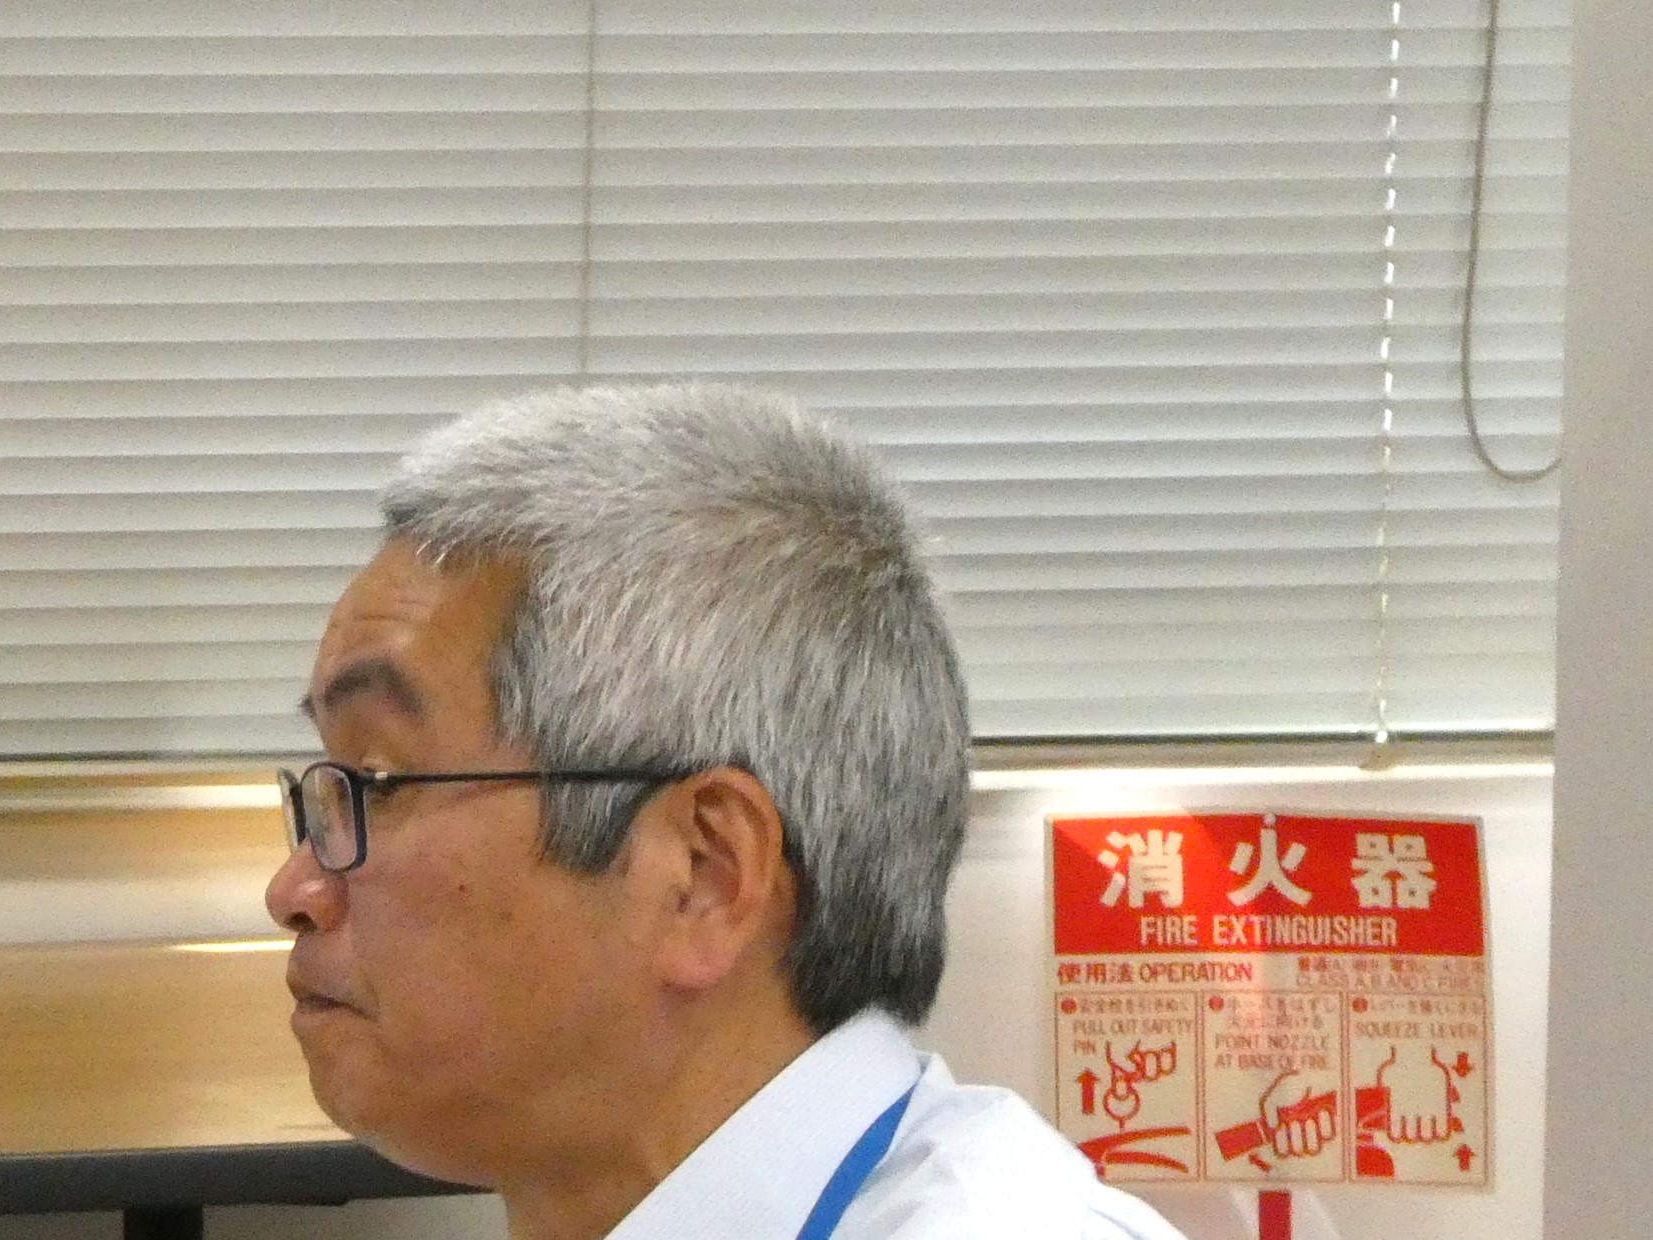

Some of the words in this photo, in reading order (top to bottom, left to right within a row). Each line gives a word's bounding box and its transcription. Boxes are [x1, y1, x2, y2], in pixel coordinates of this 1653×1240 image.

[1097, 828, 1438, 909] 消火器
[1140, 914, 1198, 946] FIRE
[1212, 914, 1397, 946] EXTINGUISHER
[1139, 961, 1253, 984] OPERATION
